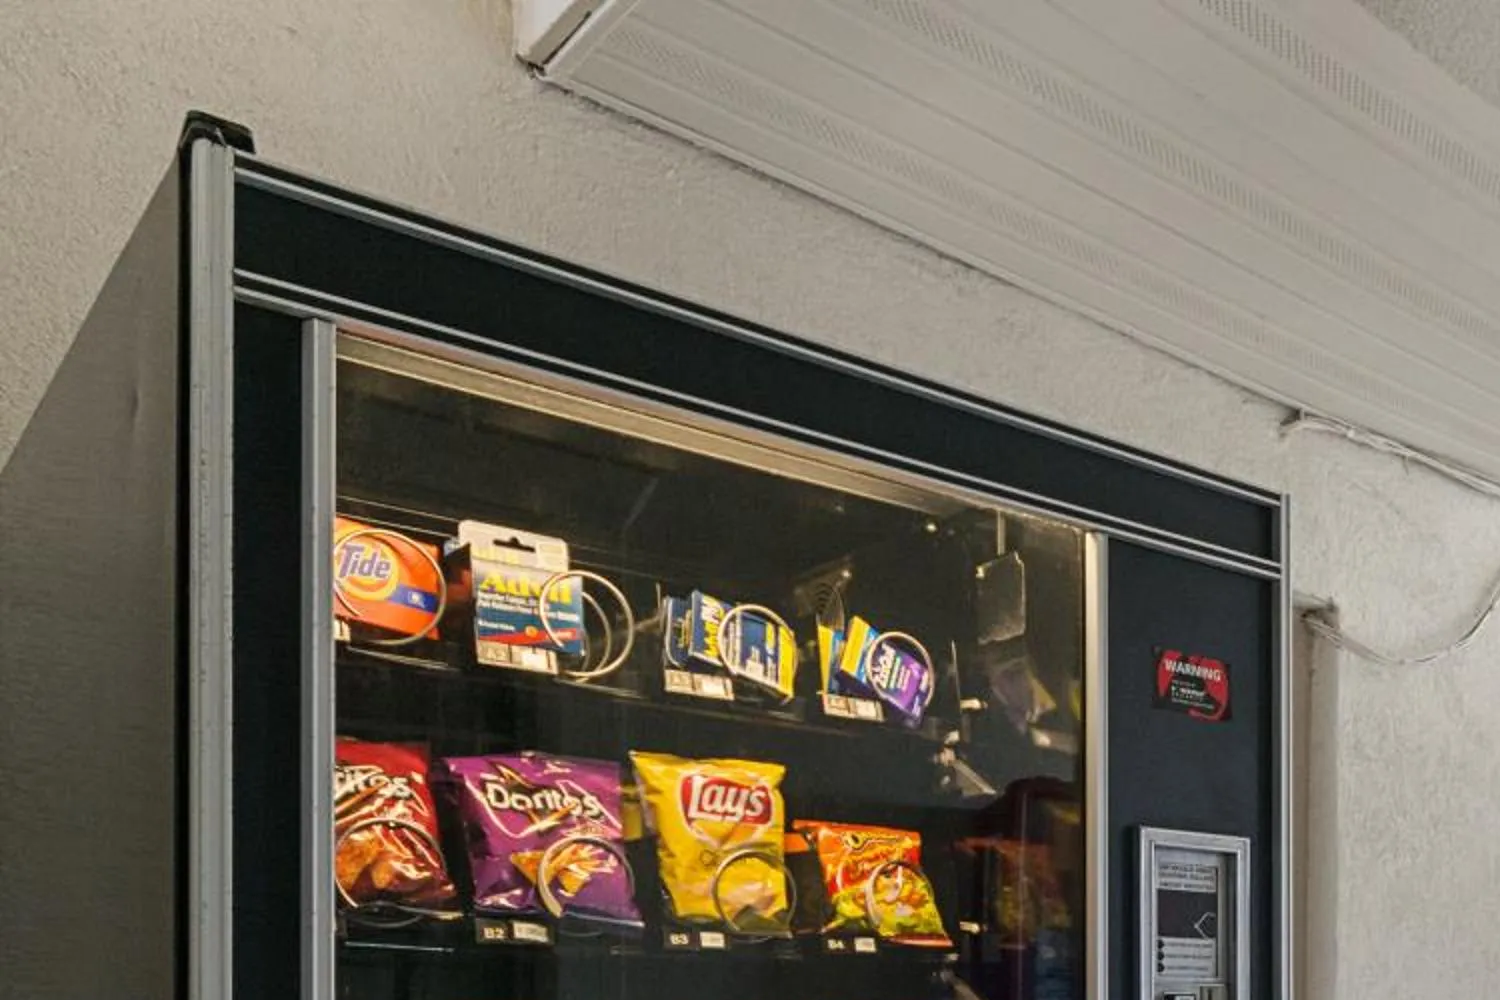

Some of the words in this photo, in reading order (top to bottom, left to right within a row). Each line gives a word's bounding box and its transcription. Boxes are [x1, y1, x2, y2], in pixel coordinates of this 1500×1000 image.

[339, 543, 391, 579] Tide
[1164, 659, 1221, 682] WARNING
[336, 767, 410, 804] ritos
[484, 780, 603, 823] Doritos
[688, 774, 768, 823] Lay's
